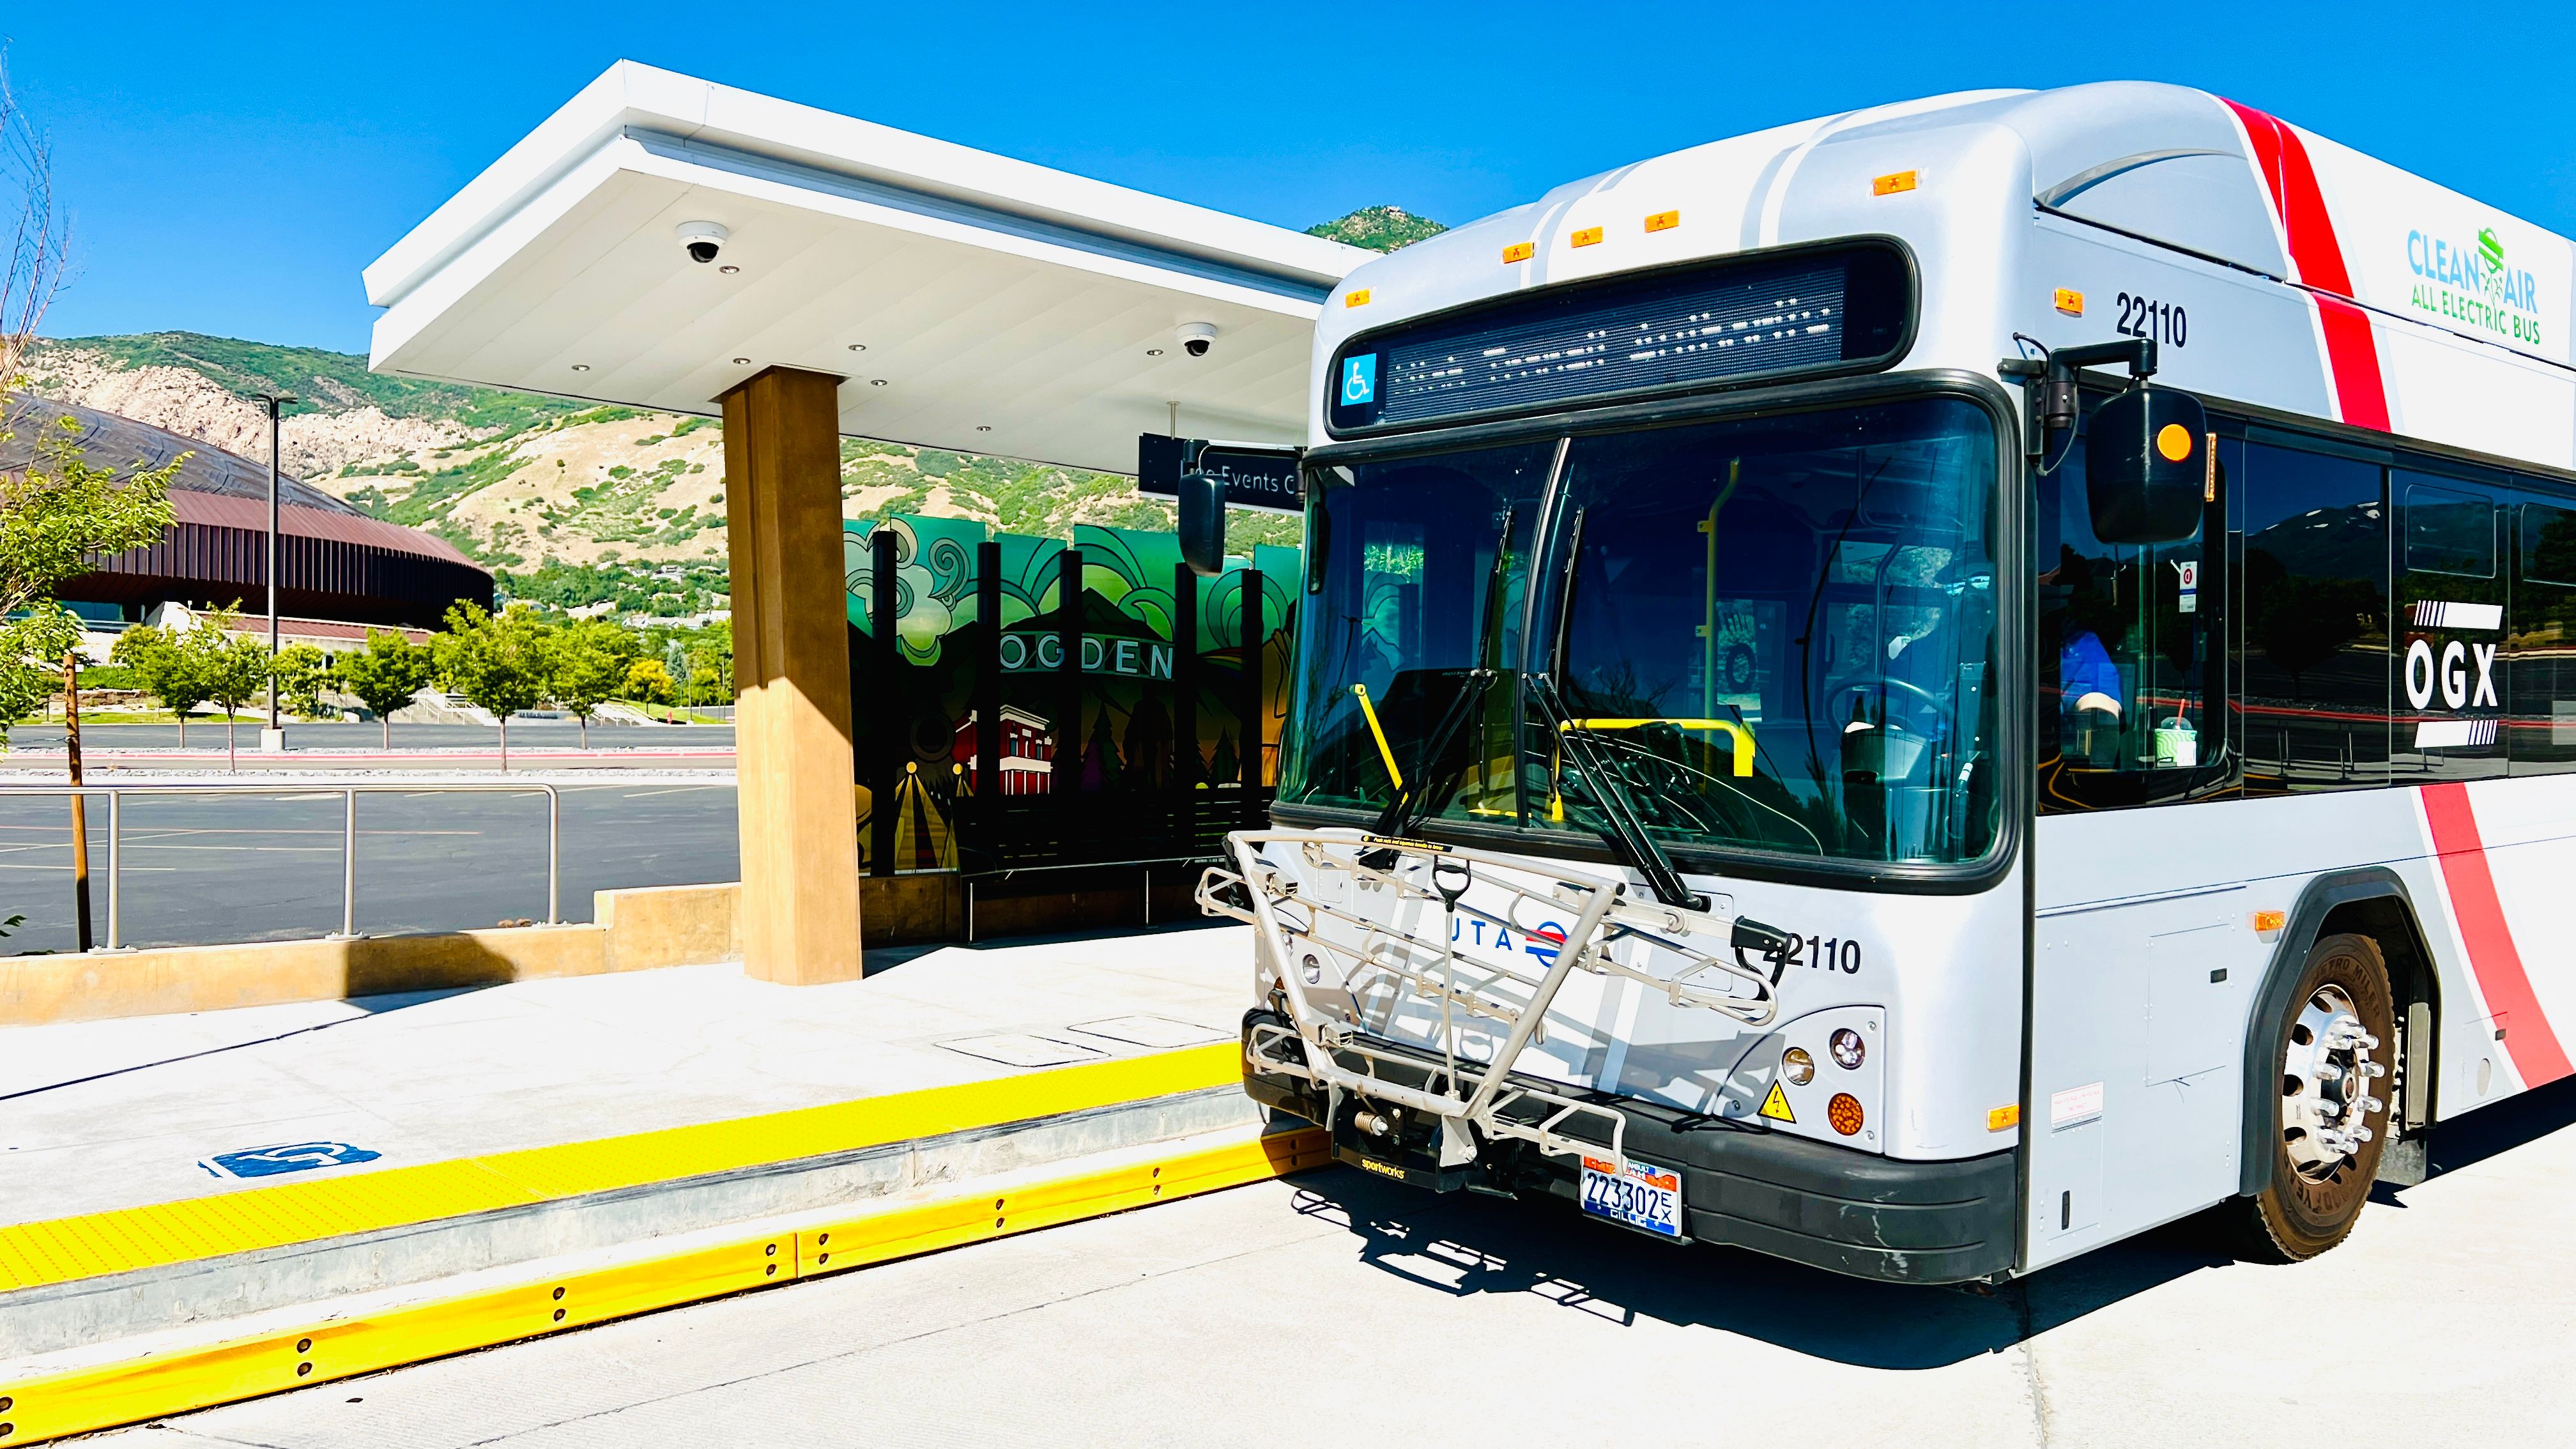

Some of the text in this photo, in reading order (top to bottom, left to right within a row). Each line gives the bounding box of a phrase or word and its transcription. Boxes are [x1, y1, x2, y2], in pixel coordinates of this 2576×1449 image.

[2407, 229, 2538, 314] CLEAN AIR
[2117, 292, 2187, 348] 22110
[2411, 283, 2540, 345] ALL ELECTRIC BUS
[1222, 465, 1278, 493] Events
[1000, 634, 1174, 679] OGDEN
[2405, 640, 2498, 710] OGX
[1361, 1158, 1405, 1179] sportworks
[1587, 1172, 1659, 1220] 223302
[1610, 1209, 1646, 1227] GILLIG
